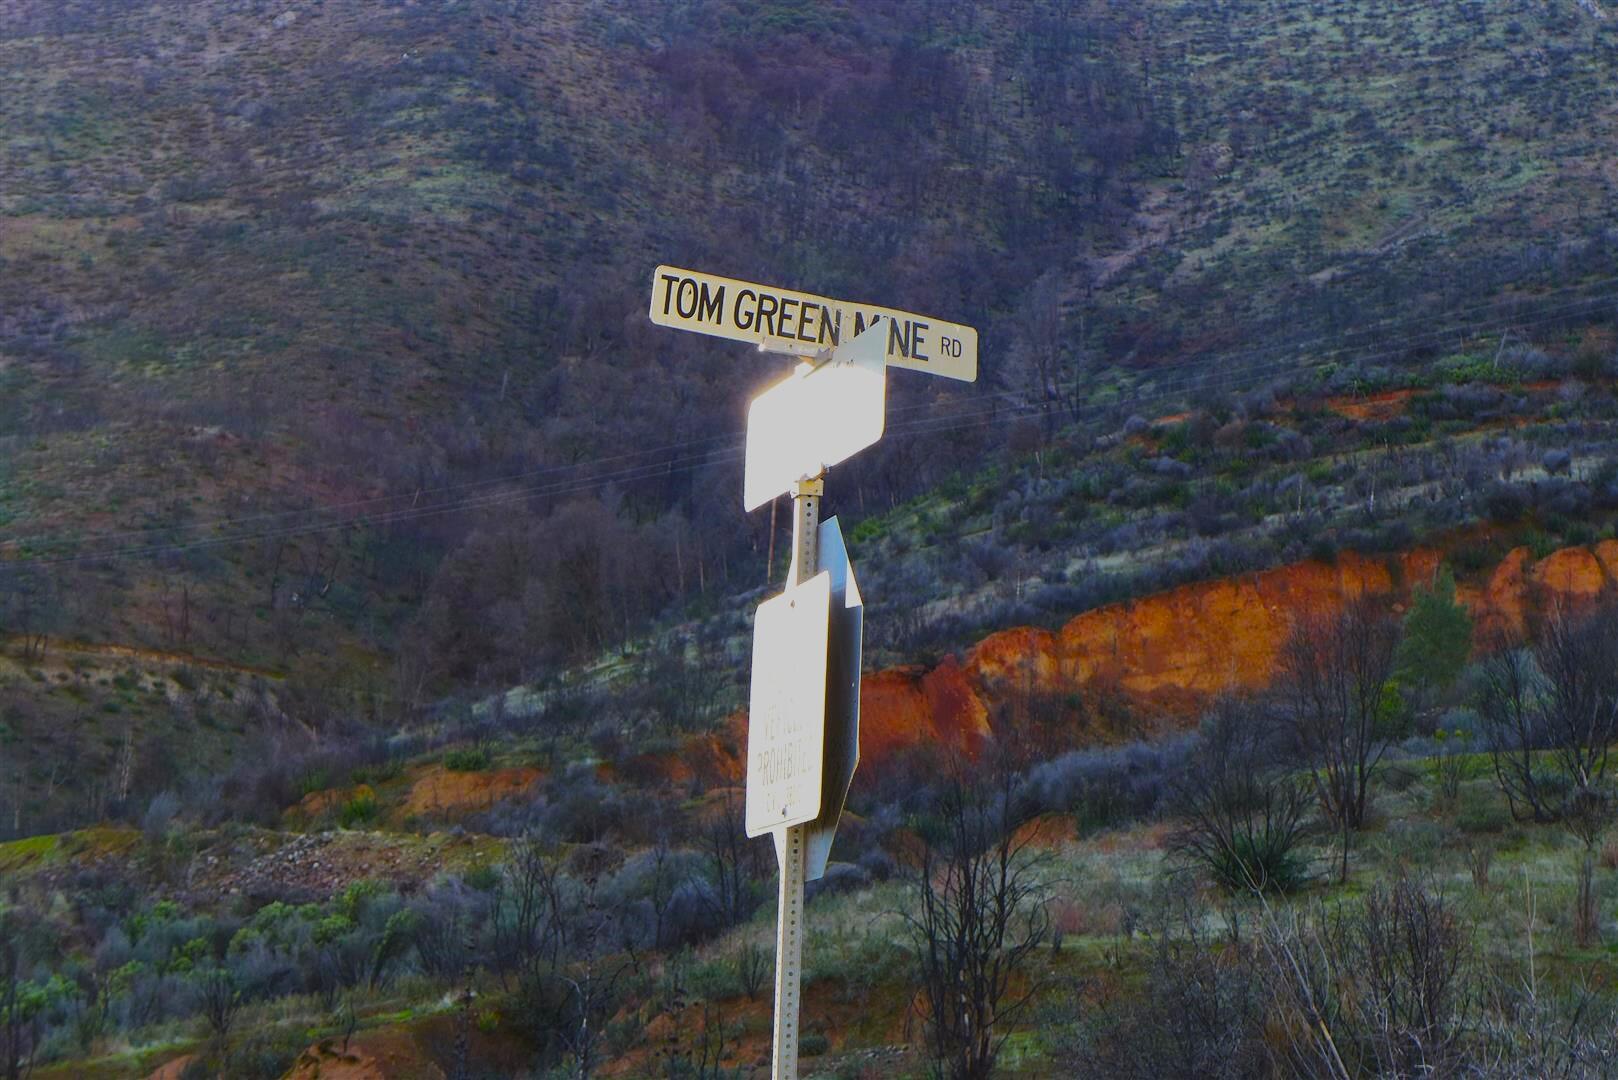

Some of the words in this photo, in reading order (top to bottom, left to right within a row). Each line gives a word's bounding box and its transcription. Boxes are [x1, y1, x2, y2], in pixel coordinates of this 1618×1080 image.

[661, 275, 725, 324] TOM
[734, 289, 841, 346] GREEN
[855, 311, 929, 361] MNE
[941, 337, 962, 358] RD
